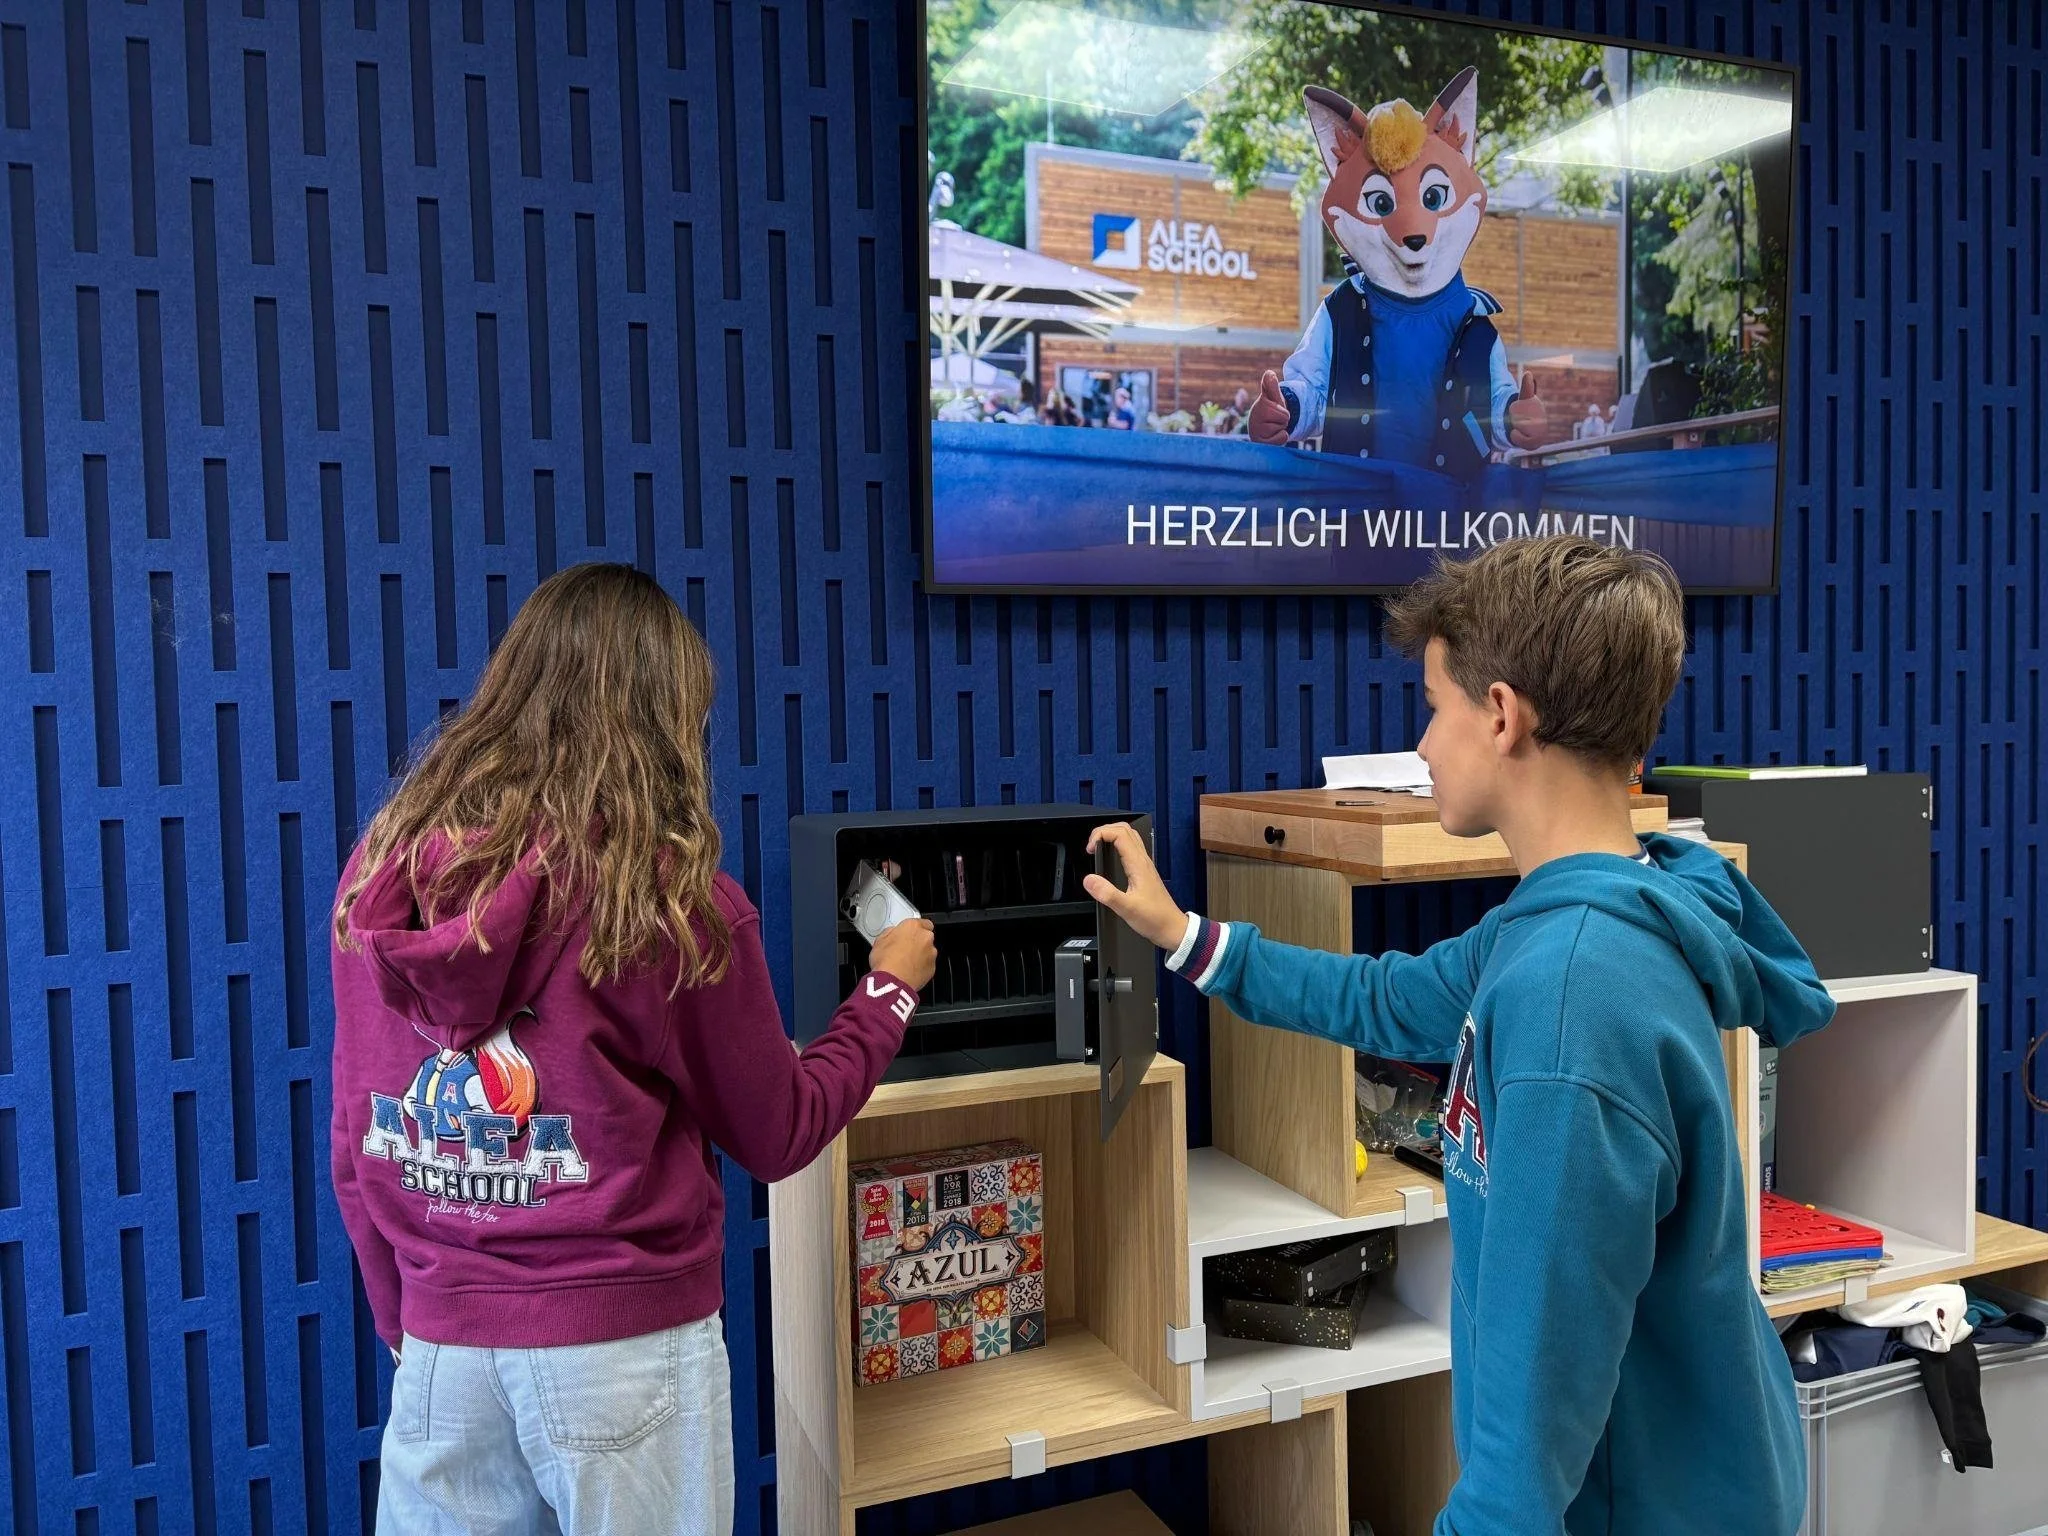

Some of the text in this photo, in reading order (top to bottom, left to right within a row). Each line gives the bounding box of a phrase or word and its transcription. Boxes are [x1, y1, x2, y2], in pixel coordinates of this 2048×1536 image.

[1148, 218, 1223, 252] ALEA
[1148, 244, 1257, 280] SCHOOL
[1127, 505, 1347, 548] HERZLICH
[443, 1082, 458, 1104] A
[363, 1092, 590, 1182] ALEA
[401, 1158, 546, 1207] SCHOOL
[425, 1198, 462, 1223] follow
[463, 1202, 481, 1218] the
[906, 1214, 926, 1225] 2018
[943, 1198, 962, 1208] 2018
[869, 1218, 886, 1228] 2018
[906, 1247, 1000, 1290] AZUL
